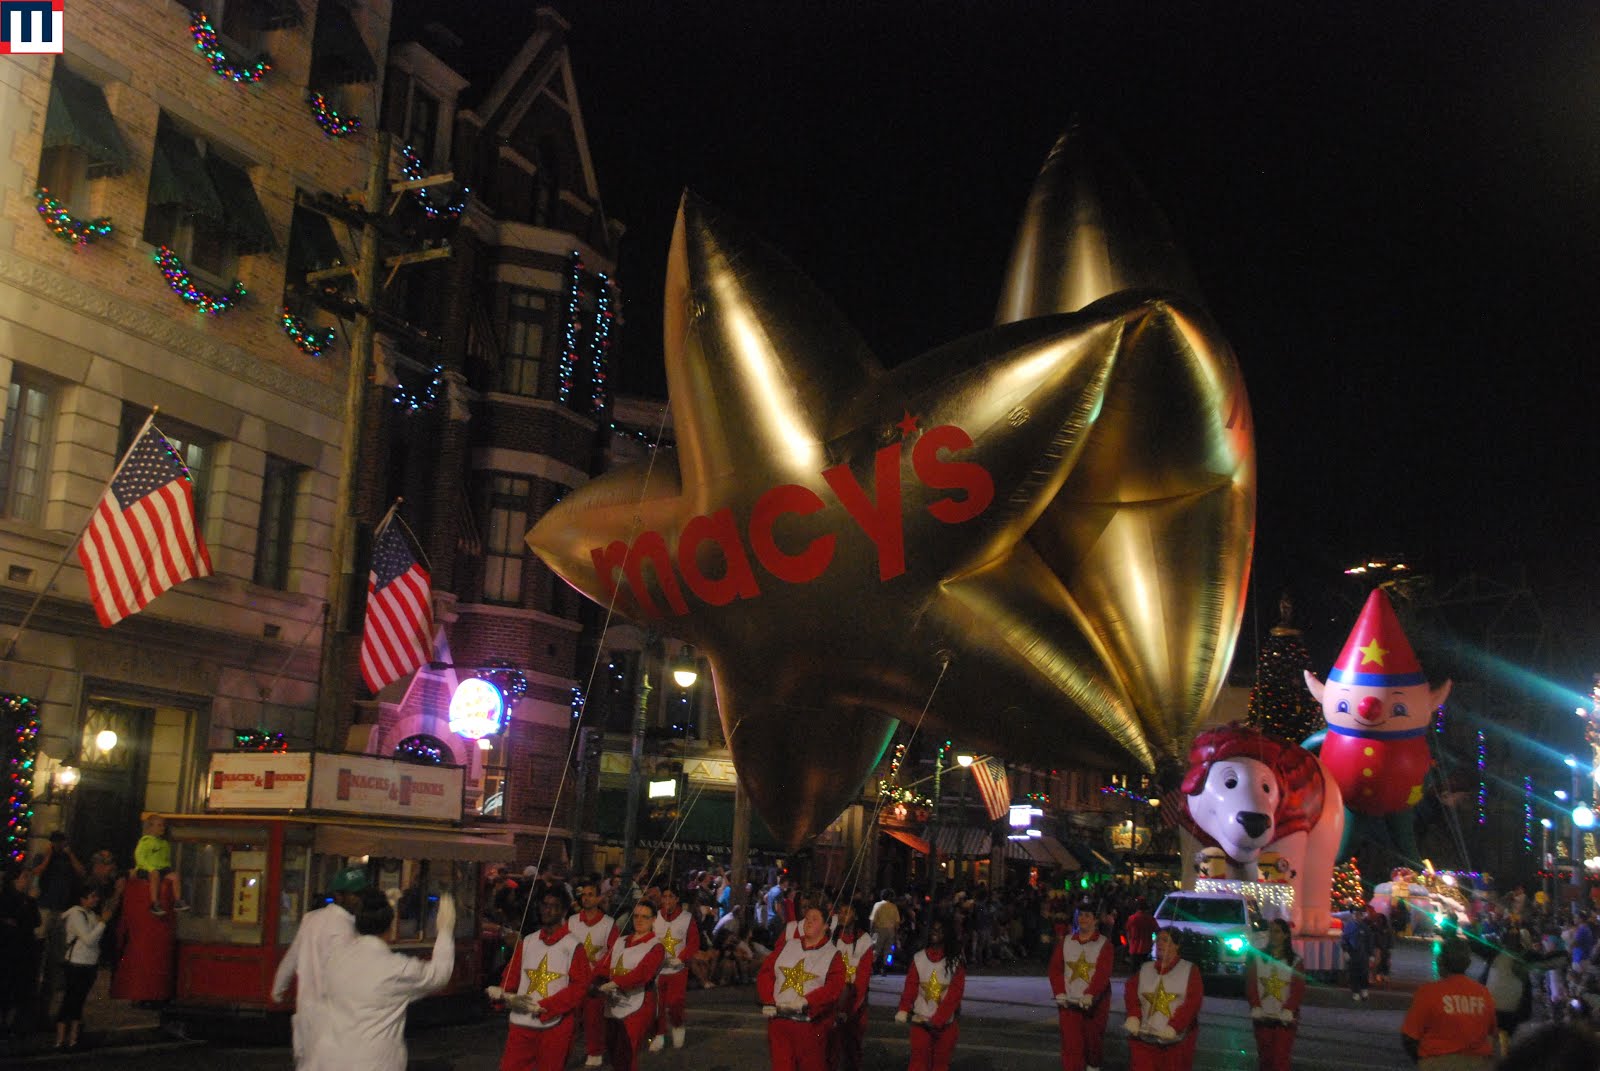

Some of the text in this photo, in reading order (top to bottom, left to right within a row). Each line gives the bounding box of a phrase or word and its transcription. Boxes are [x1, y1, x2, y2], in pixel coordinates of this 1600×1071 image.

[590, 410, 995, 620] macy's
[213, 771, 255, 789] NACKS
[264, 771, 306, 789] RINKS
[337, 768, 389, 800] NACKS
[399, 775, 445, 805] RINKS
[1442, 994, 1485, 1016] STAFF
